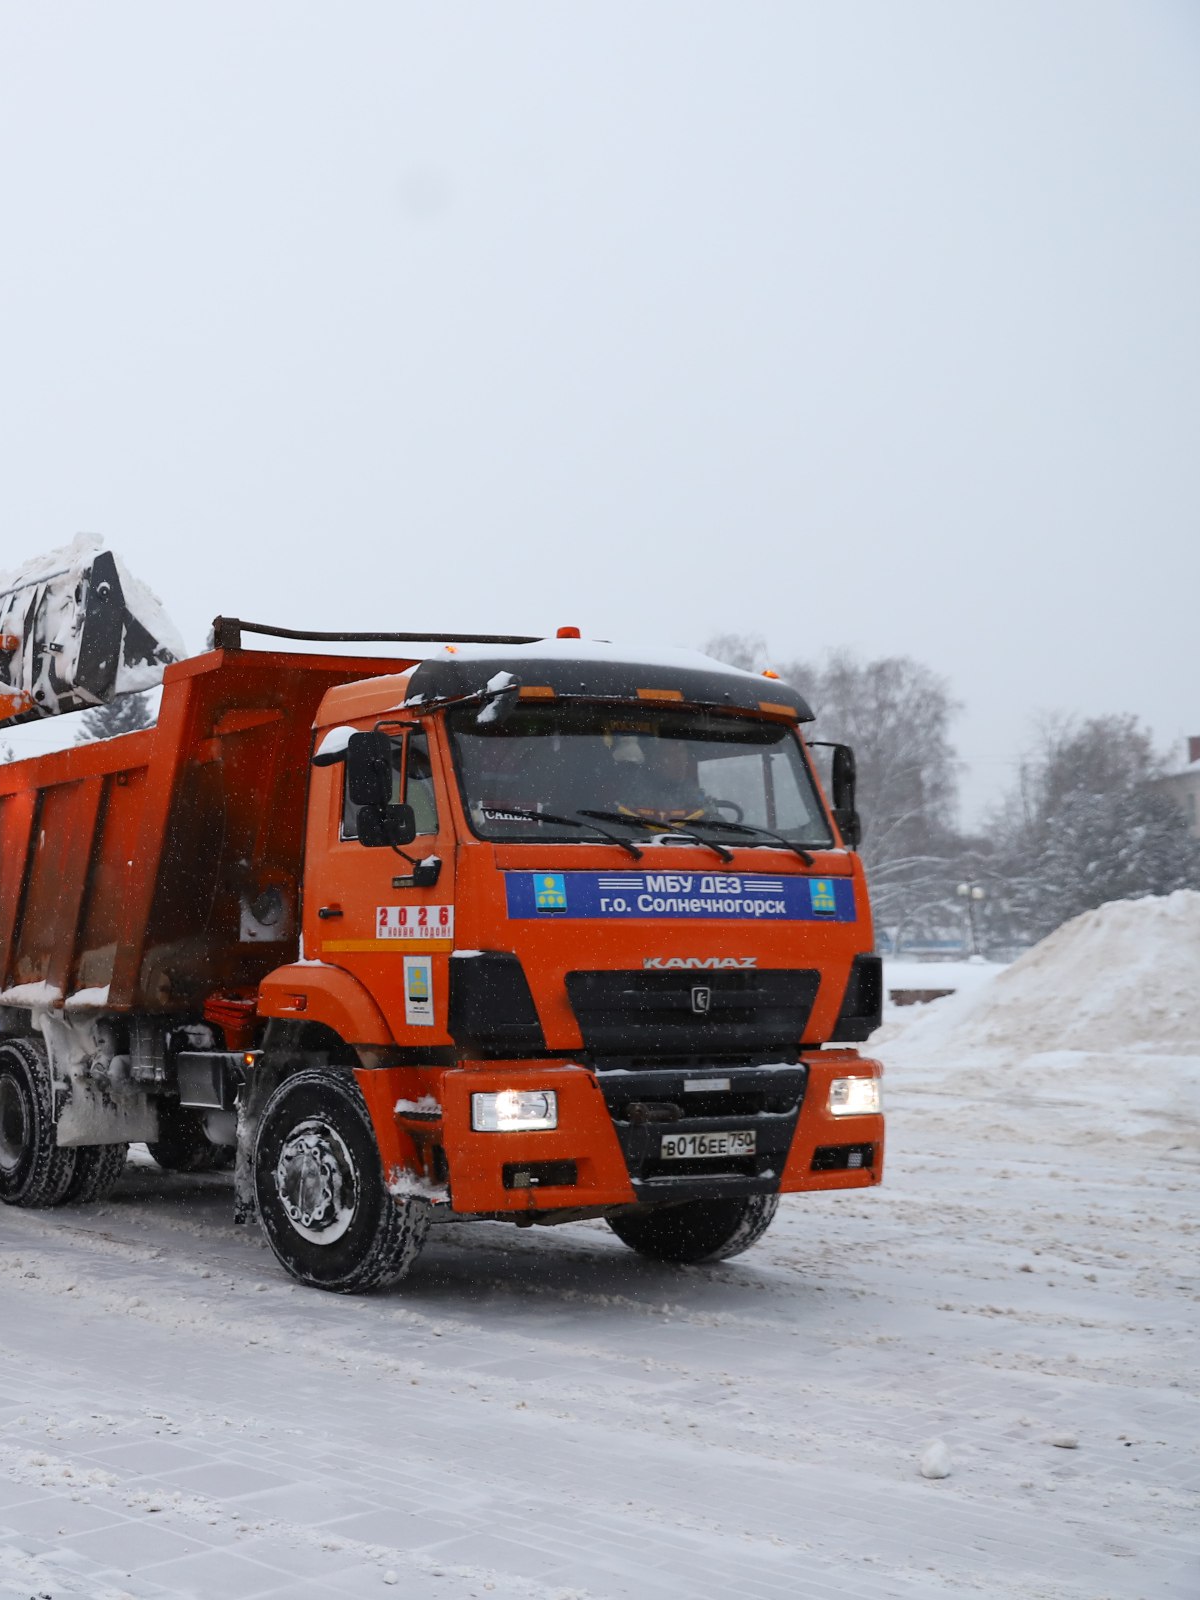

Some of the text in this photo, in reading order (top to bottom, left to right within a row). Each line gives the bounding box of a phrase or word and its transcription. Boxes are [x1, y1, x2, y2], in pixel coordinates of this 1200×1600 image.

[646, 876, 741, 894] МБУ ДЕЗ
[601, 894, 786, 916] г.о. Солнечногорск
[380, 907, 448, 926] 2026
[643, 957, 757, 969] KAMAZ
[730, 1133, 753, 1147] 750
